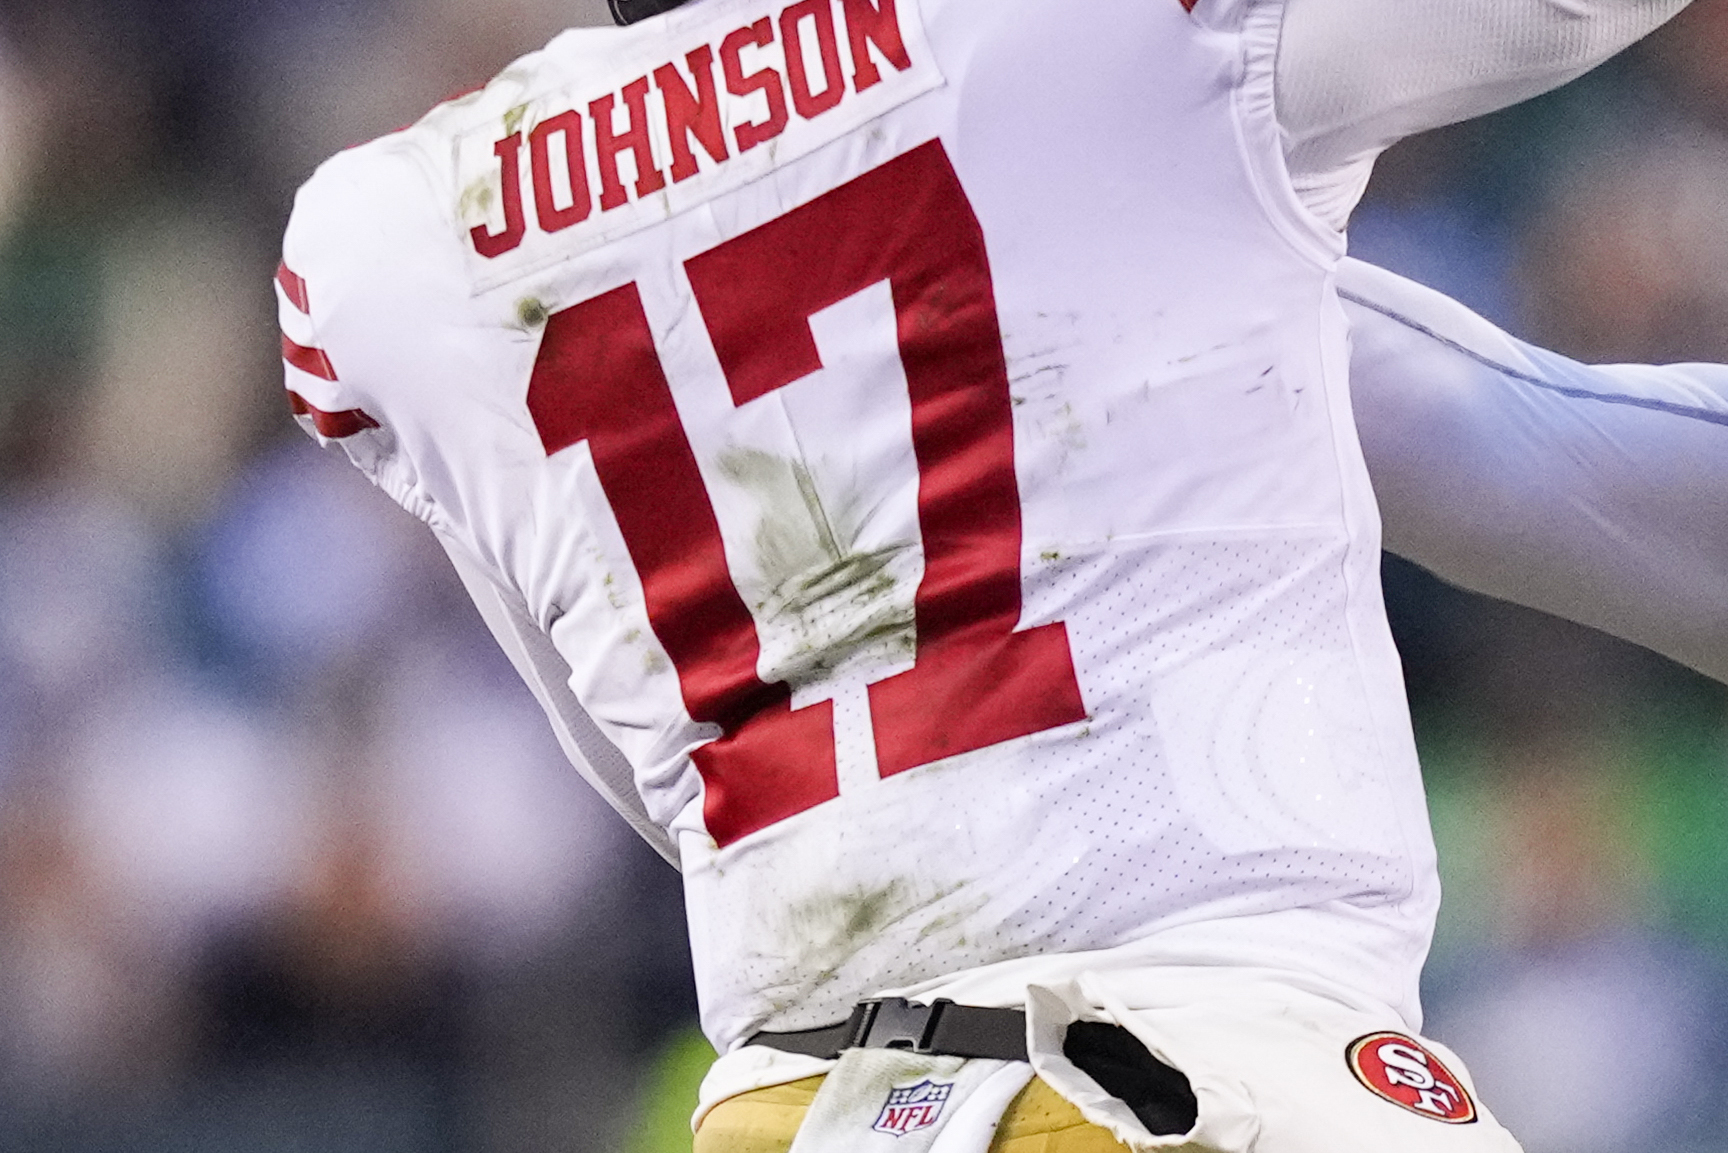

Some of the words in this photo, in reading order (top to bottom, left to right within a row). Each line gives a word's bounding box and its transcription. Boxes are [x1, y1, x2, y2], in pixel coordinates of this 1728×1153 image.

[526, 136, 1087, 850] 17
[1377, 1042, 1462, 1117] SF
[879, 1104, 935, 1132] NFL
